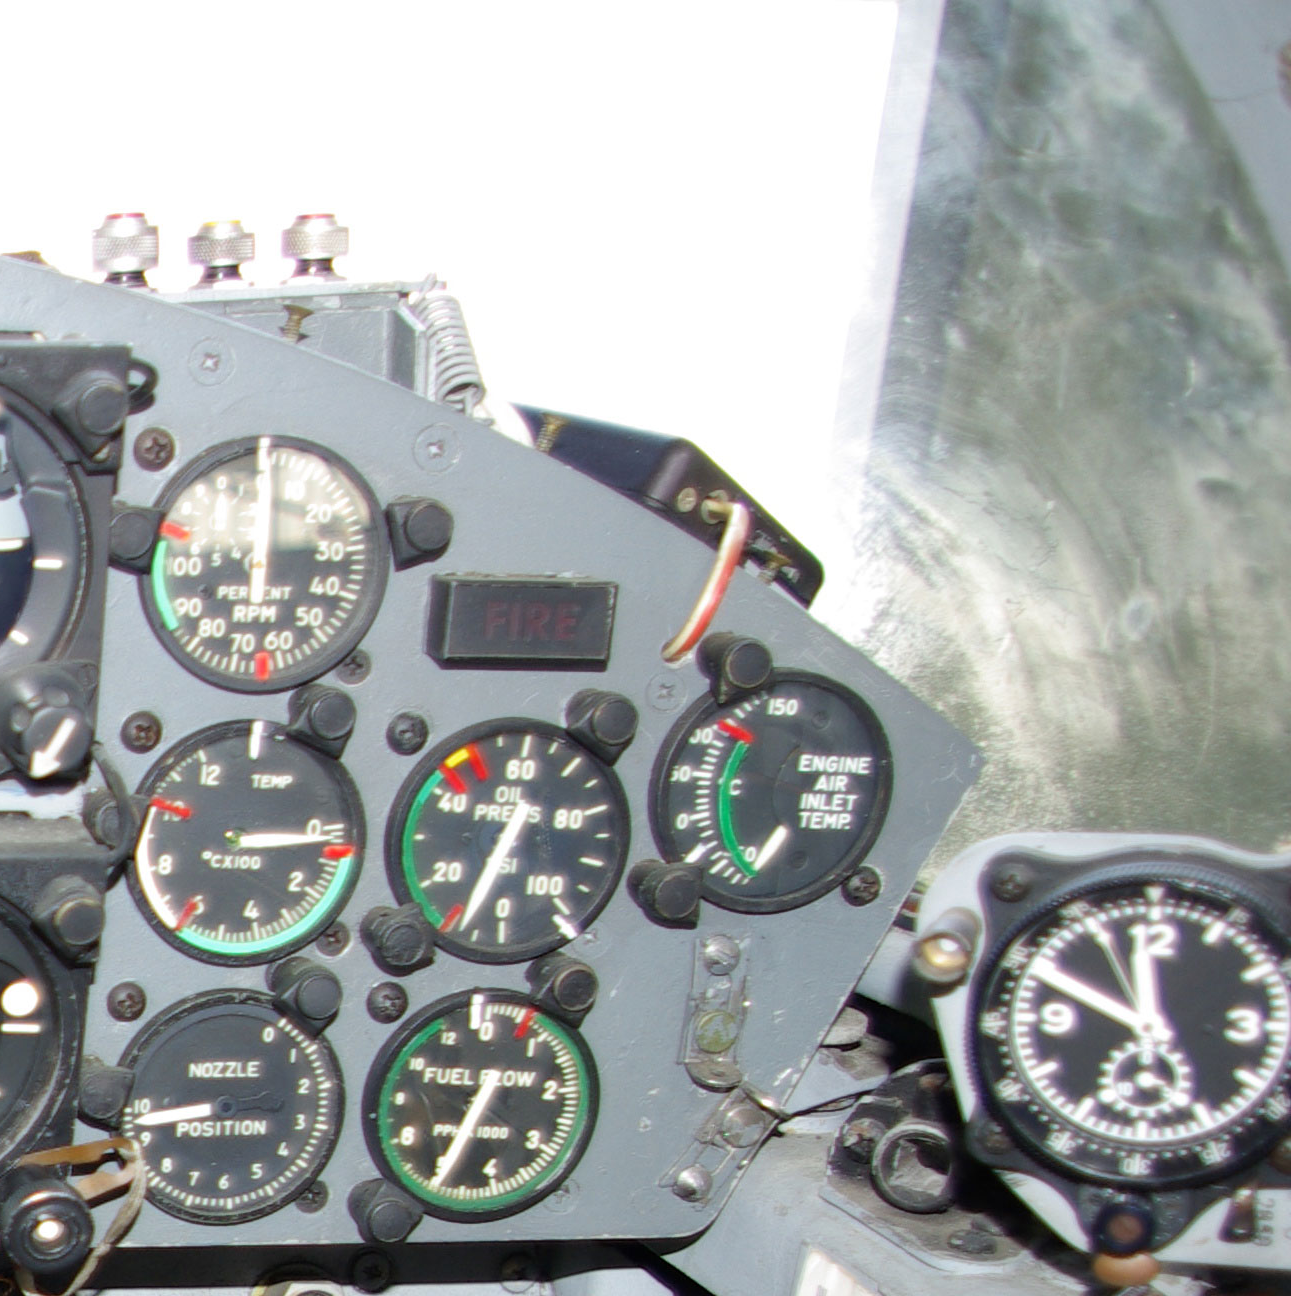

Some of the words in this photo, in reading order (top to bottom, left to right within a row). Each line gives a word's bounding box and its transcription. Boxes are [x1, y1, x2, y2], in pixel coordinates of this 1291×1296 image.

[233, 605, 276, 624] RPM
[486, 601, 579, 642] FIRE
[797, 754, 873, 775] ENGINE
[251, 773, 292, 789] TEMP
[813, 775, 848, 792] AIR
[799, 792, 859, 812] INLET
[188, 1061, 260, 1079] NOZZLE
[423, 1067, 474, 1087] FUEL
[176, 1119, 267, 1138] POSITION
